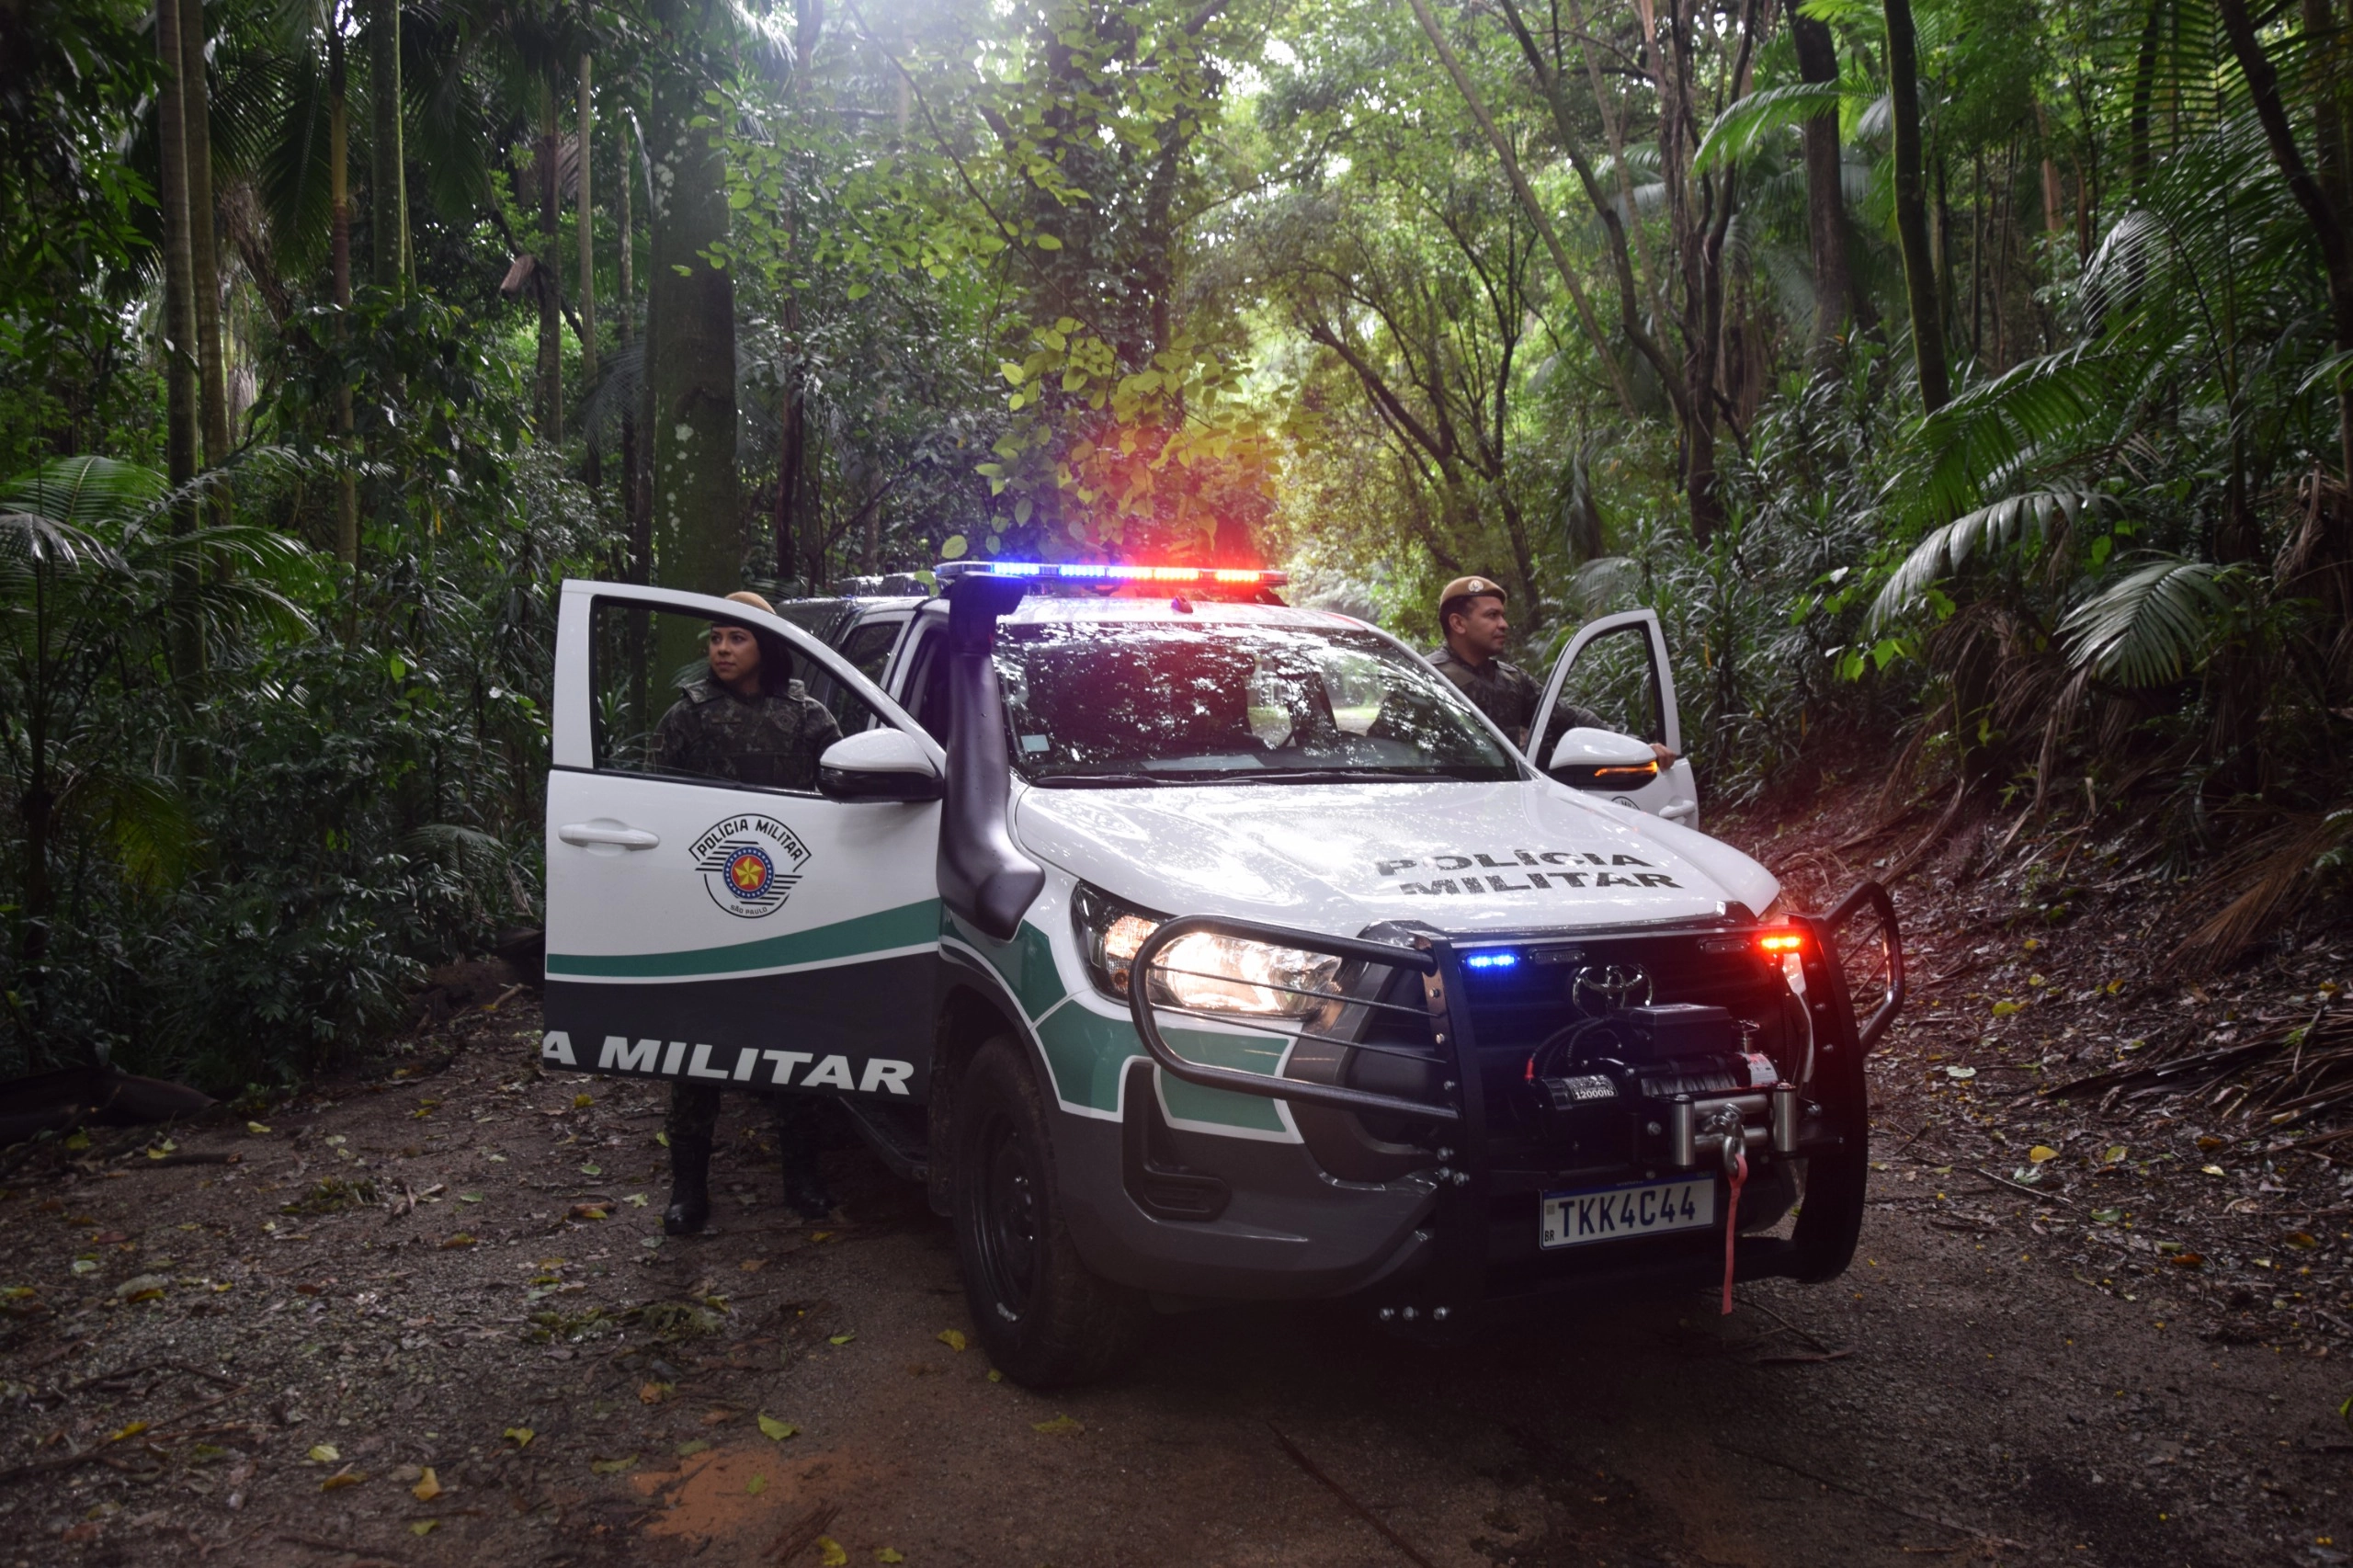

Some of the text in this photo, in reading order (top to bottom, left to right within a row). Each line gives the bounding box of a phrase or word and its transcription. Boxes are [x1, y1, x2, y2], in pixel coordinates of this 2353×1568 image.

[697, 819, 803, 861] POLÍCIA MILITAR
[1375, 849, 1655, 877] POLÍCIA
[1399, 872, 1685, 895] MILITAR
[730, 904, 768, 915] SÃO PAULO
[597, 1035, 914, 1096] MILITAR
[1558, 1186, 1696, 1238] TKK4C44
[1544, 1230, 1555, 1242] BR
